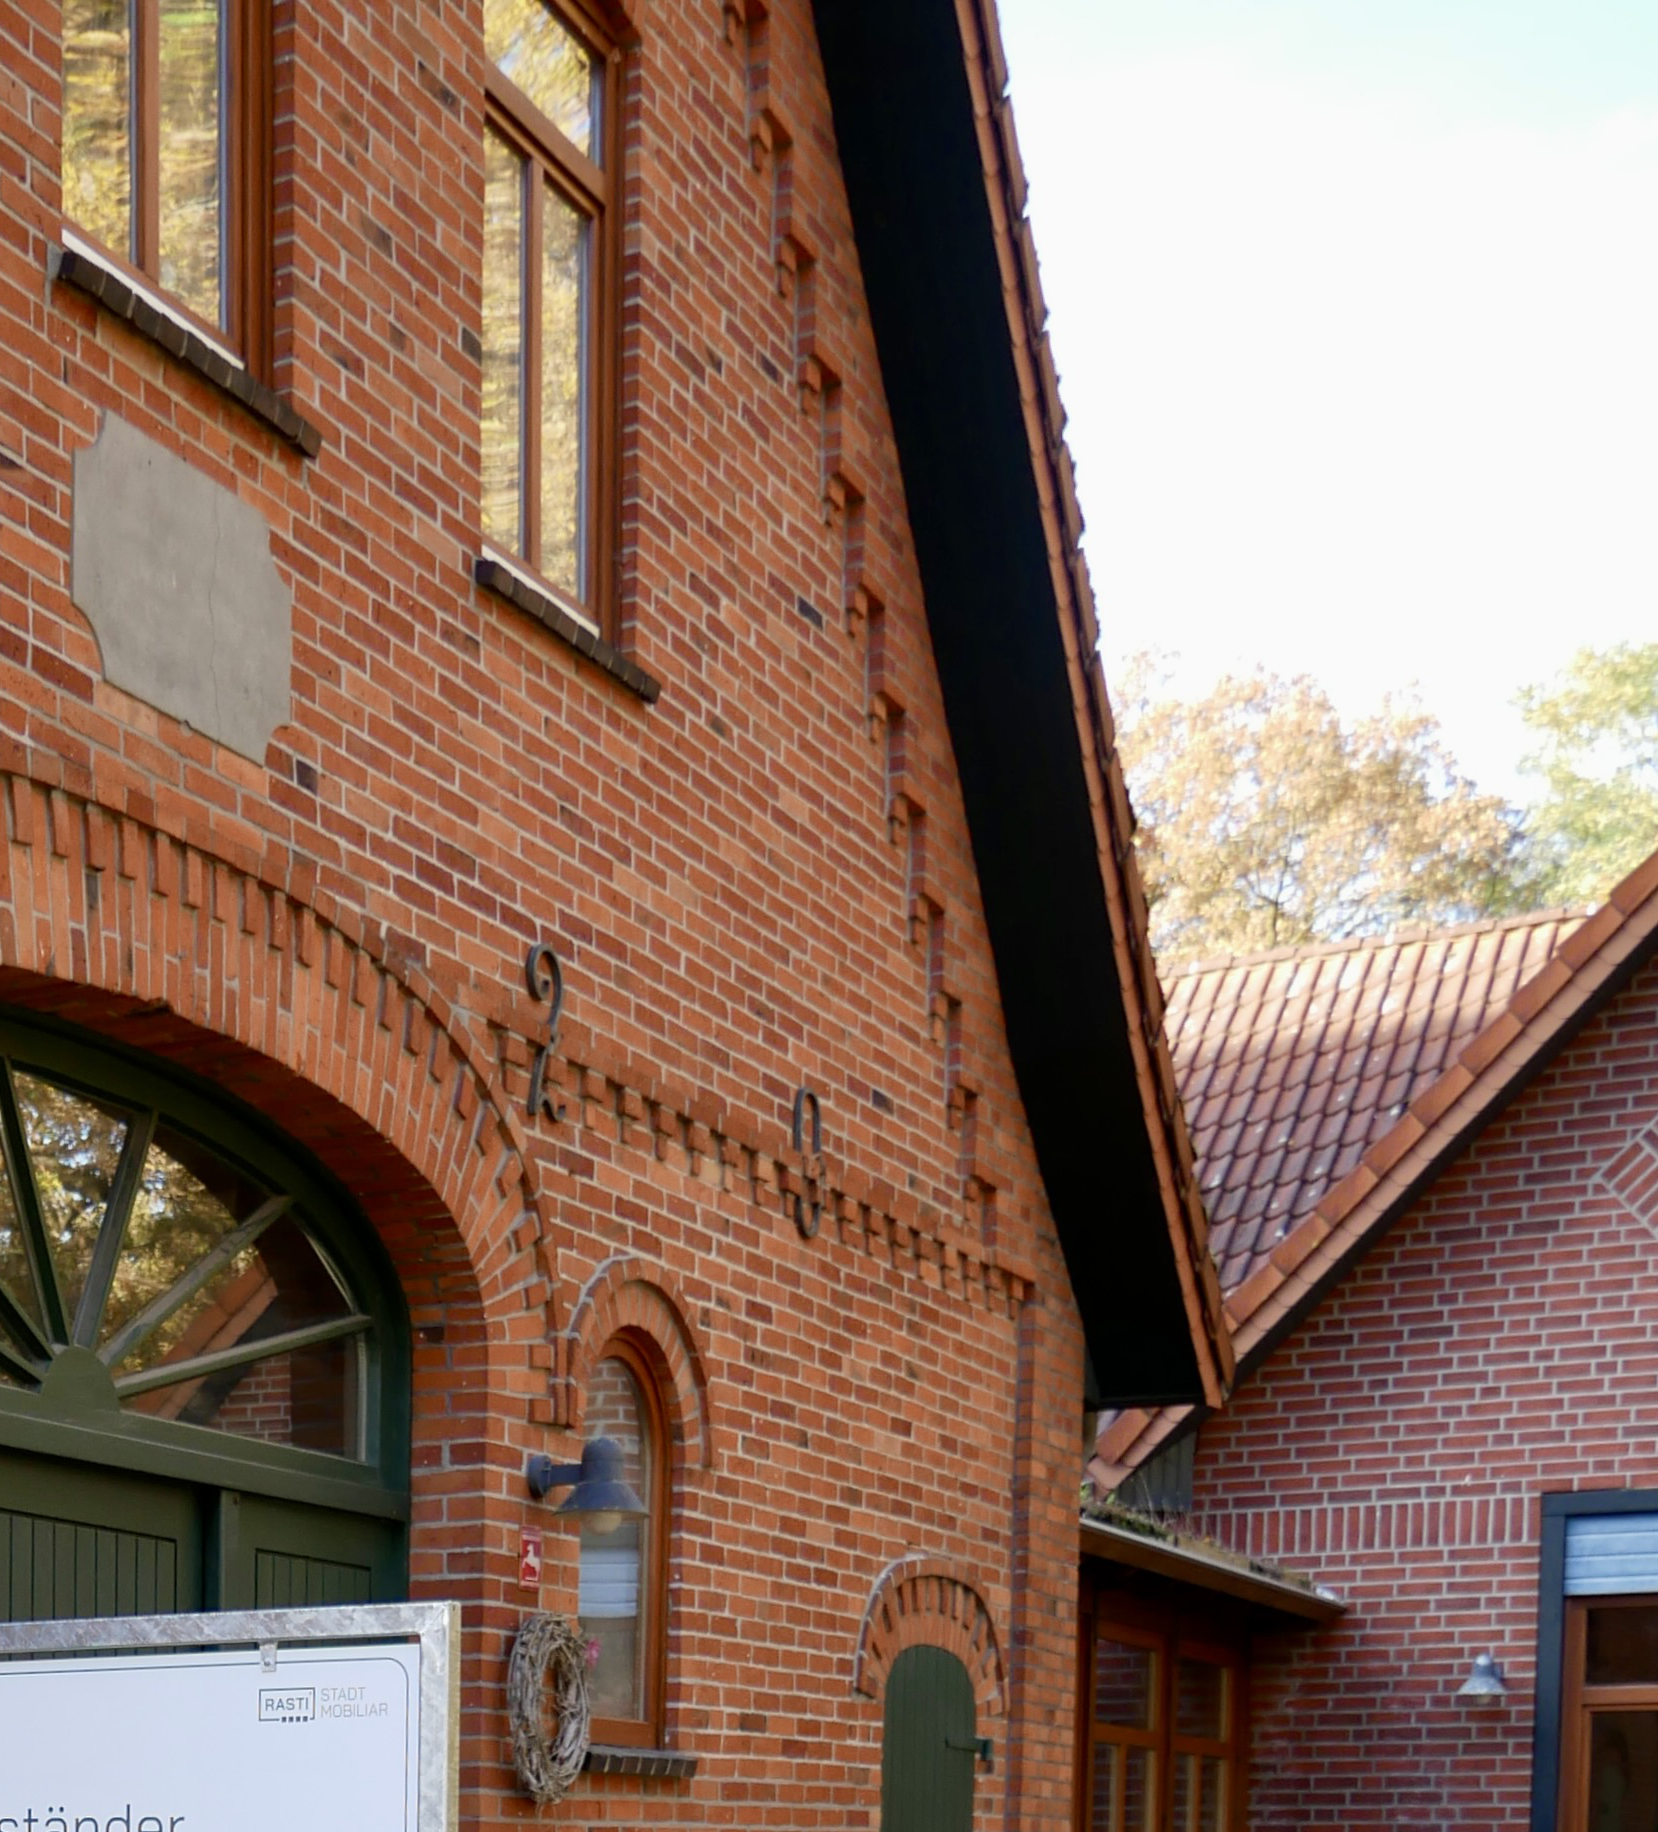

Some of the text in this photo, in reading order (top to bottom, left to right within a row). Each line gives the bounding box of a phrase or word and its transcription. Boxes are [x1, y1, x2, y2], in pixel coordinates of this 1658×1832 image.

[320, 1686, 367, 1701] STADT
[264, 1696, 310, 1712] RASTI
[320, 1702, 389, 1718] MOBILIAR
